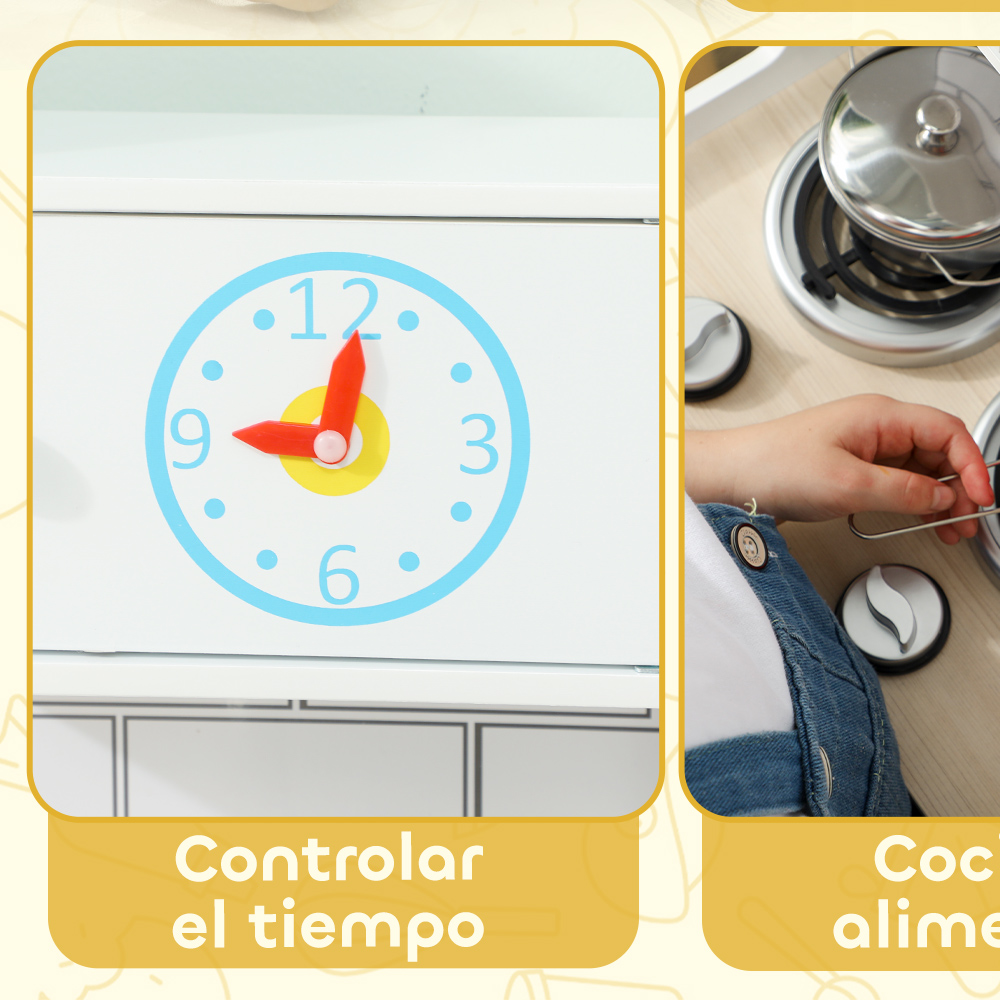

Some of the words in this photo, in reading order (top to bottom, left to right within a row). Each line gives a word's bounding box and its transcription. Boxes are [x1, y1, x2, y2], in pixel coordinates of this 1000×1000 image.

[289, 277, 382, 340] 12
[169, 408, 211, 470] 9
[459, 413, 500, 476] 3
[318, 544, 360, 606] 6
